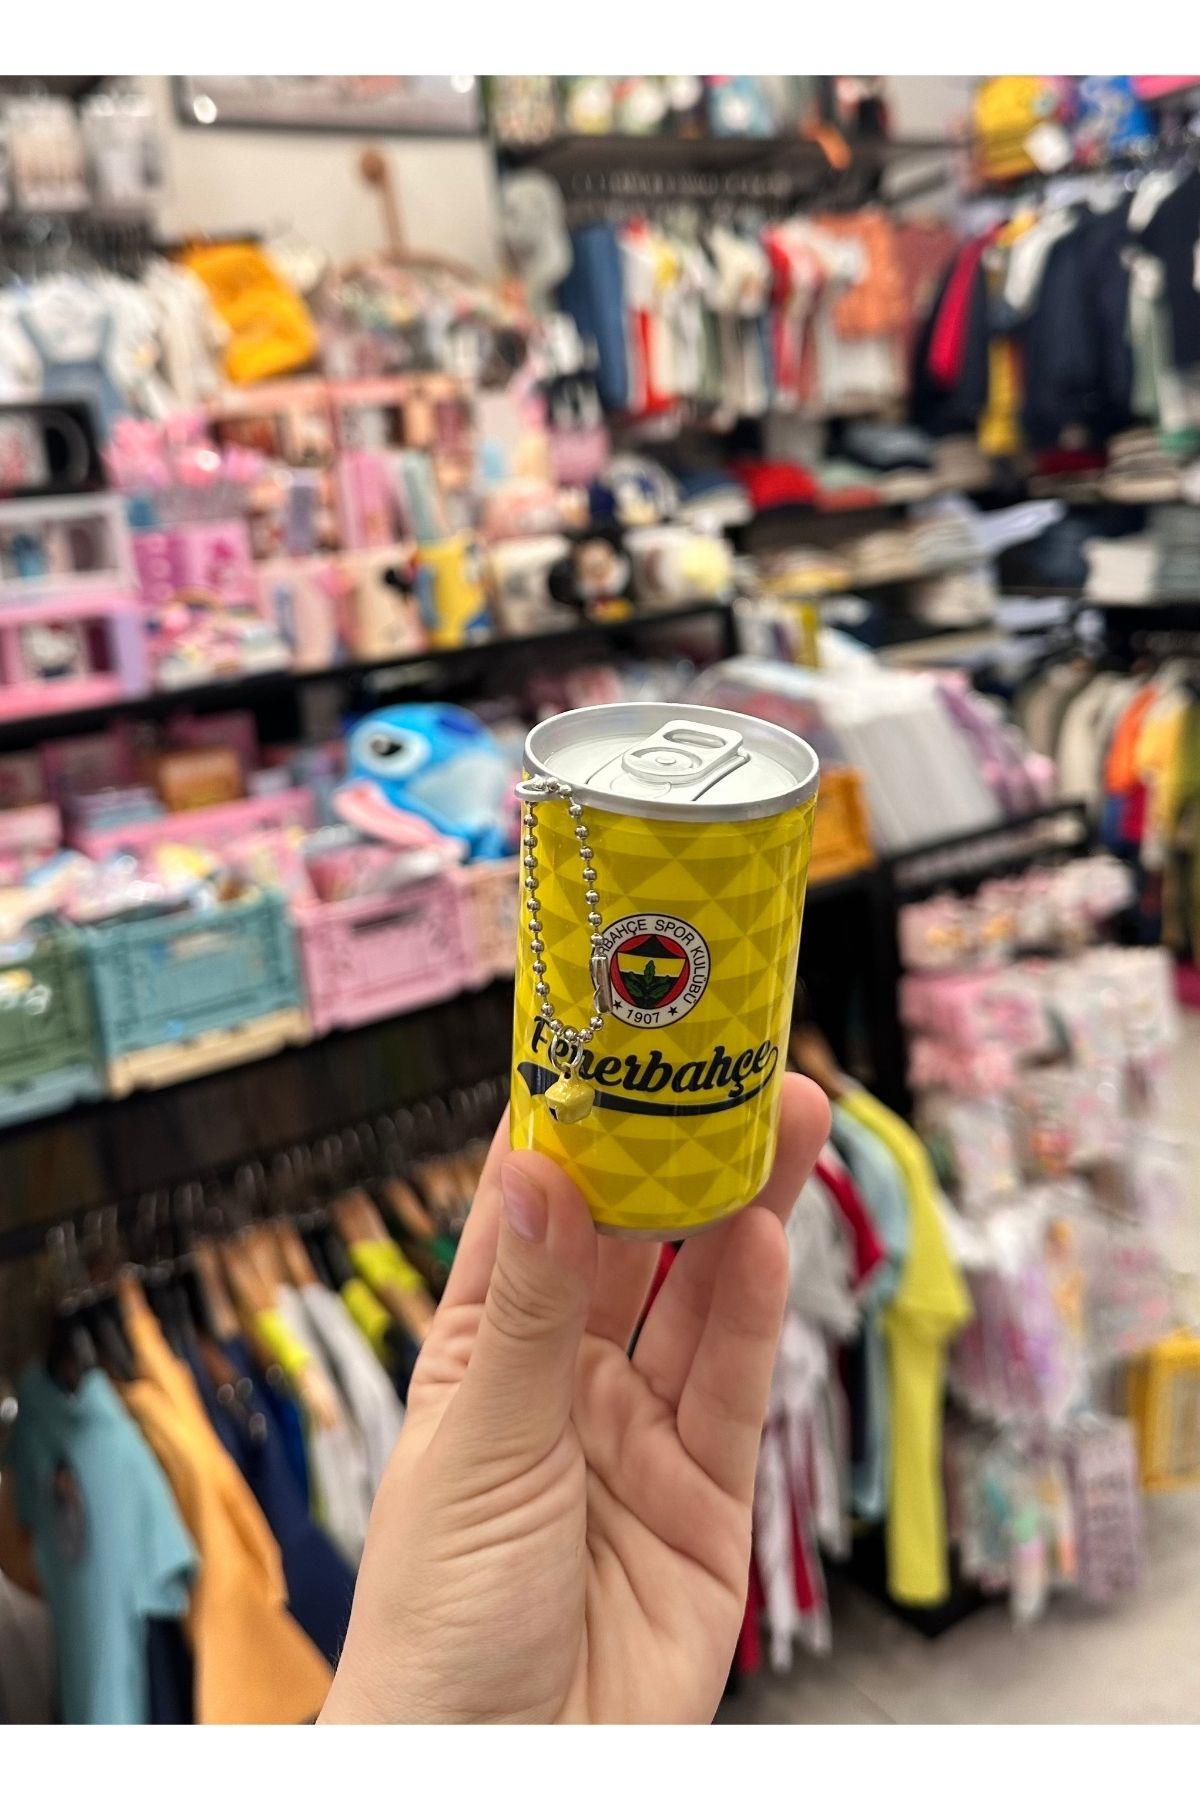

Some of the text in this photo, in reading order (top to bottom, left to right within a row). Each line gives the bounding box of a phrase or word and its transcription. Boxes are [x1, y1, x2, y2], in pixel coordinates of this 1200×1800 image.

[654, 919, 695, 946] SPOR
[682, 946, 708, 1004] KULÜBÜ
[531, 1015, 778, 1098] Fenerbahçe
[626, 1009, 660, 1024] 1907
